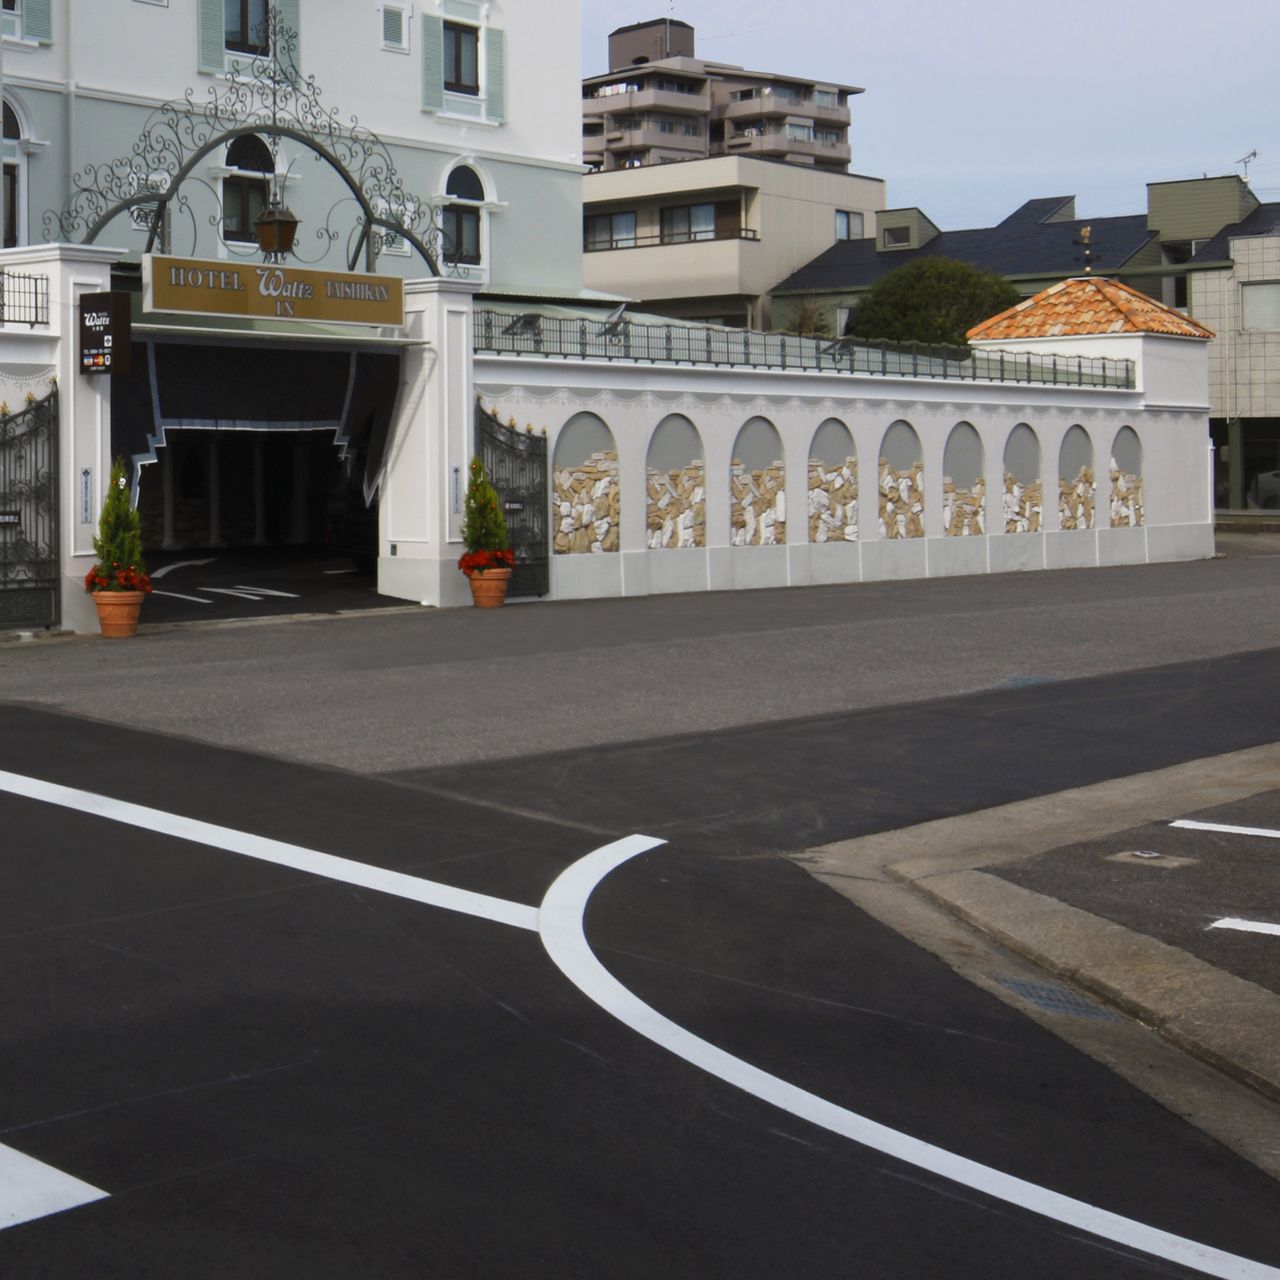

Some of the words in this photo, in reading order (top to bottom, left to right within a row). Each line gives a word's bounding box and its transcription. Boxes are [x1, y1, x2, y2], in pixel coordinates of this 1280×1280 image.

[170, 267, 245, 291] HOTEL
[255, 268, 314, 298] Waltz
[324, 281, 391, 301] TAISHIKAN
[275, 300, 295, 316] IN
[84, 312, 110, 326] Waltz
